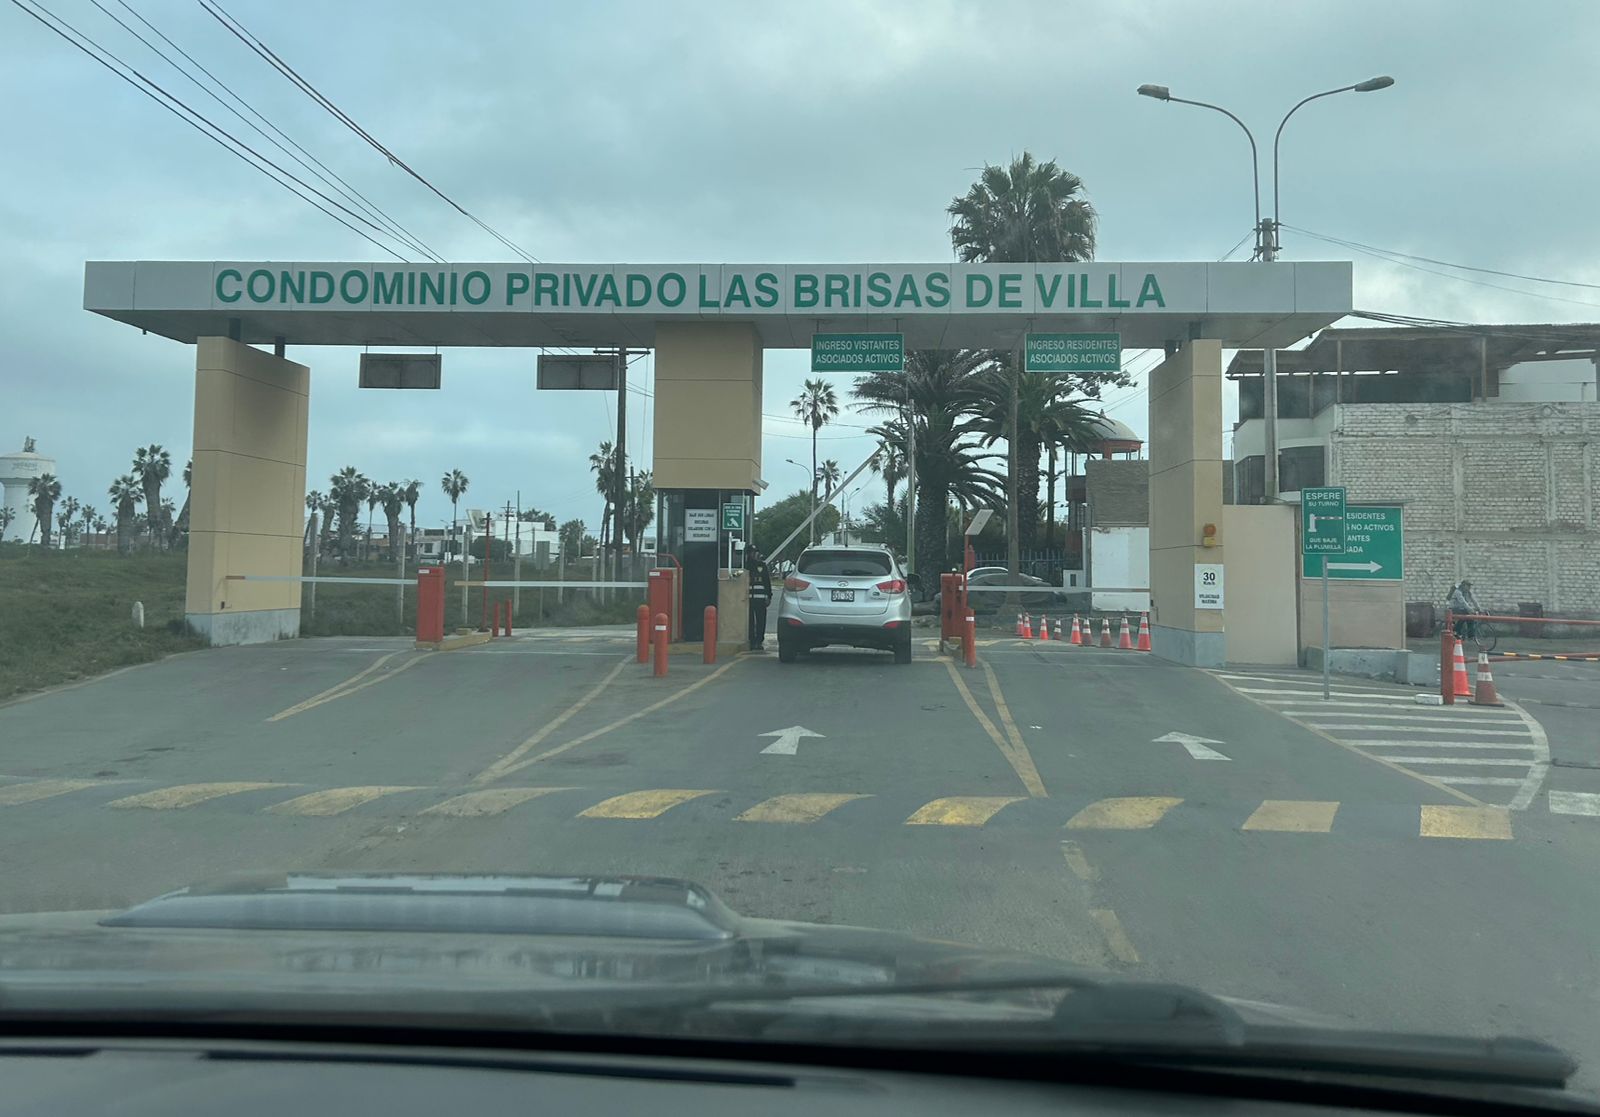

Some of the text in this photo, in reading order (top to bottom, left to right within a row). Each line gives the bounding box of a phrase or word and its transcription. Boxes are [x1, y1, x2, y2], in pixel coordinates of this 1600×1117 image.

[215, 268, 1168, 309] CONDOMINIO PRIVADO LAS BRISAS DE VILLA
[815, 340, 900, 351] INGRESO VISITANTES
[1027, 340, 1118, 350] INGRESO RESIDENTES
[815, 354, 900, 364] ASOCIADOS ACTIVOS
[1030, 354, 1116, 364] ASOCIADOS ACTIVOS
[1305, 492, 1341, 500] ESPERE
[1346, 512, 1386, 520] ESIDENTES
[1350, 523, 1363, 531] NO
[1363, 524, 1395, 532] ACTIVOS
[1346, 534, 1371, 542] ANTES
[1346, 545, 1364, 553] ADA
[1203, 572, 1216, 580] 30
